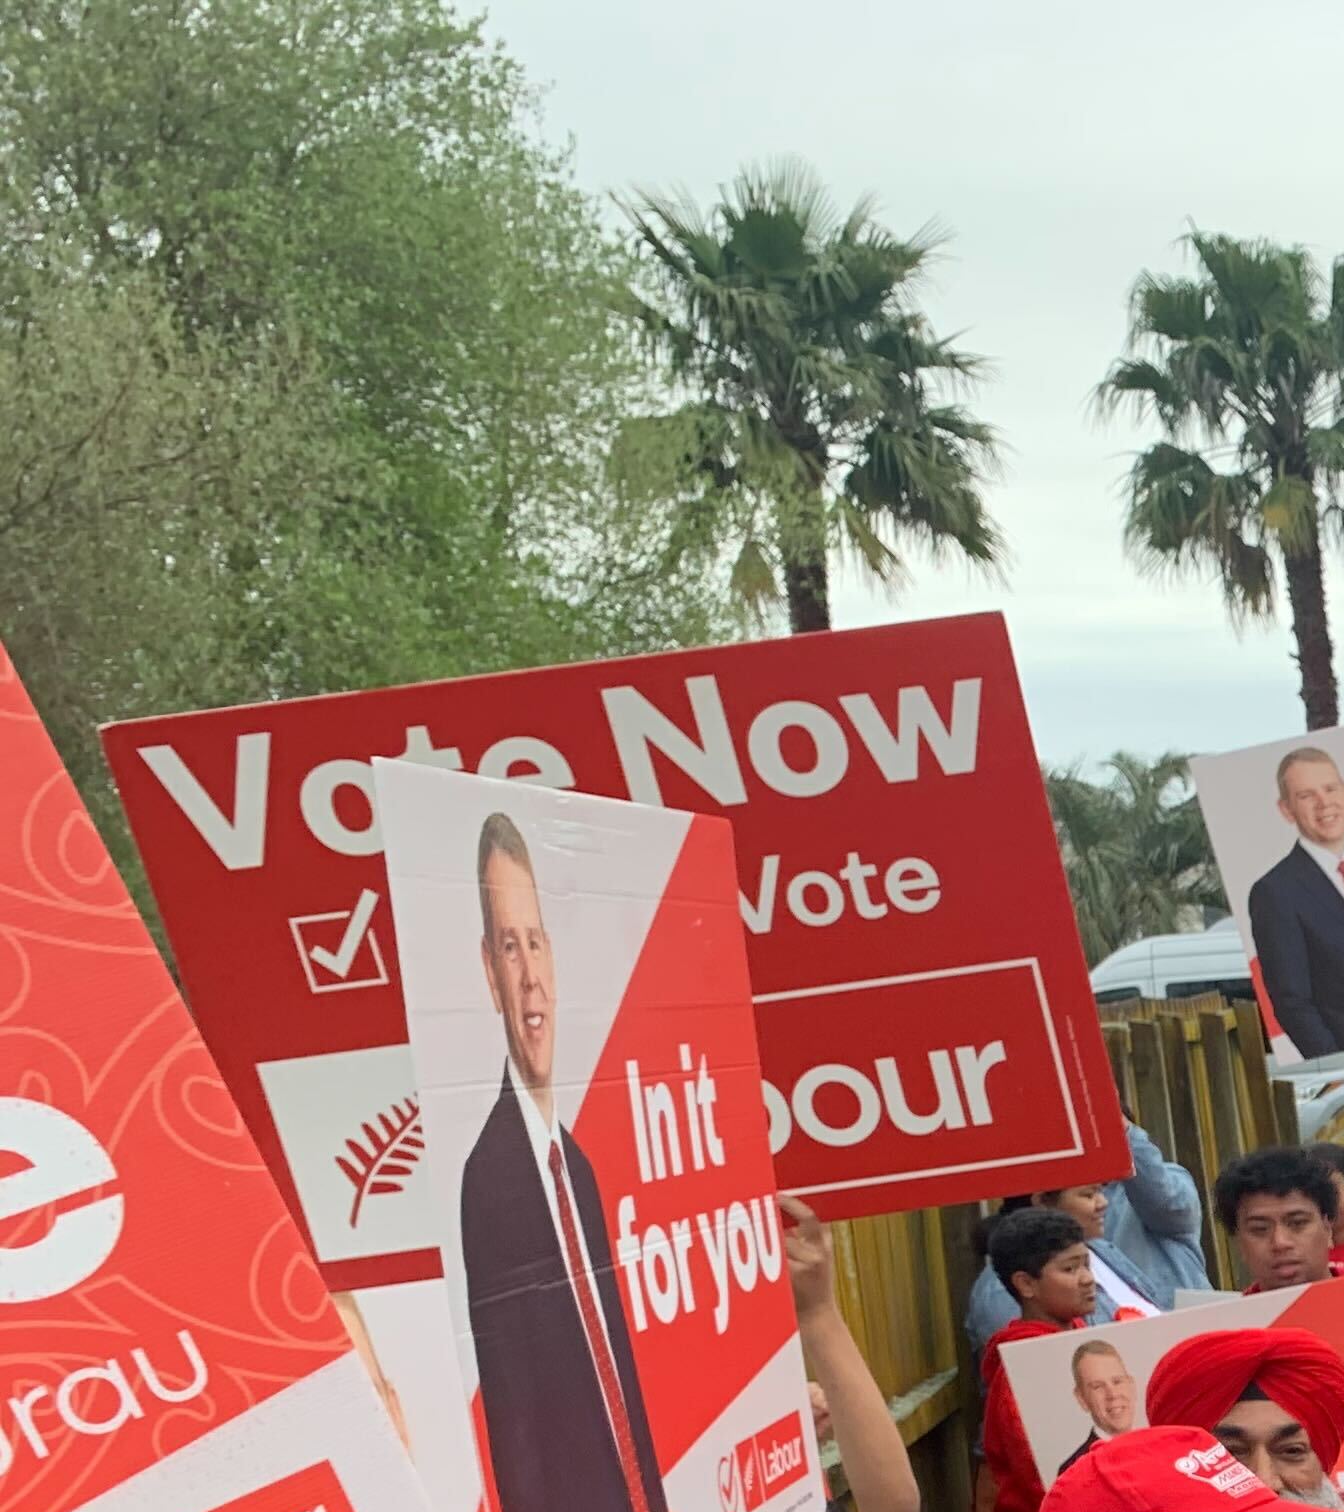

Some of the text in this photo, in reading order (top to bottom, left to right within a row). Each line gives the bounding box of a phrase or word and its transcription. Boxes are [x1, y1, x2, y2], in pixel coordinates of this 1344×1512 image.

[601, 673, 982, 806] Now
[626, 1043, 725, 1183] In it
[617, 1194, 783, 1334] for you
[760, 1436, 801, 1485] Labour
